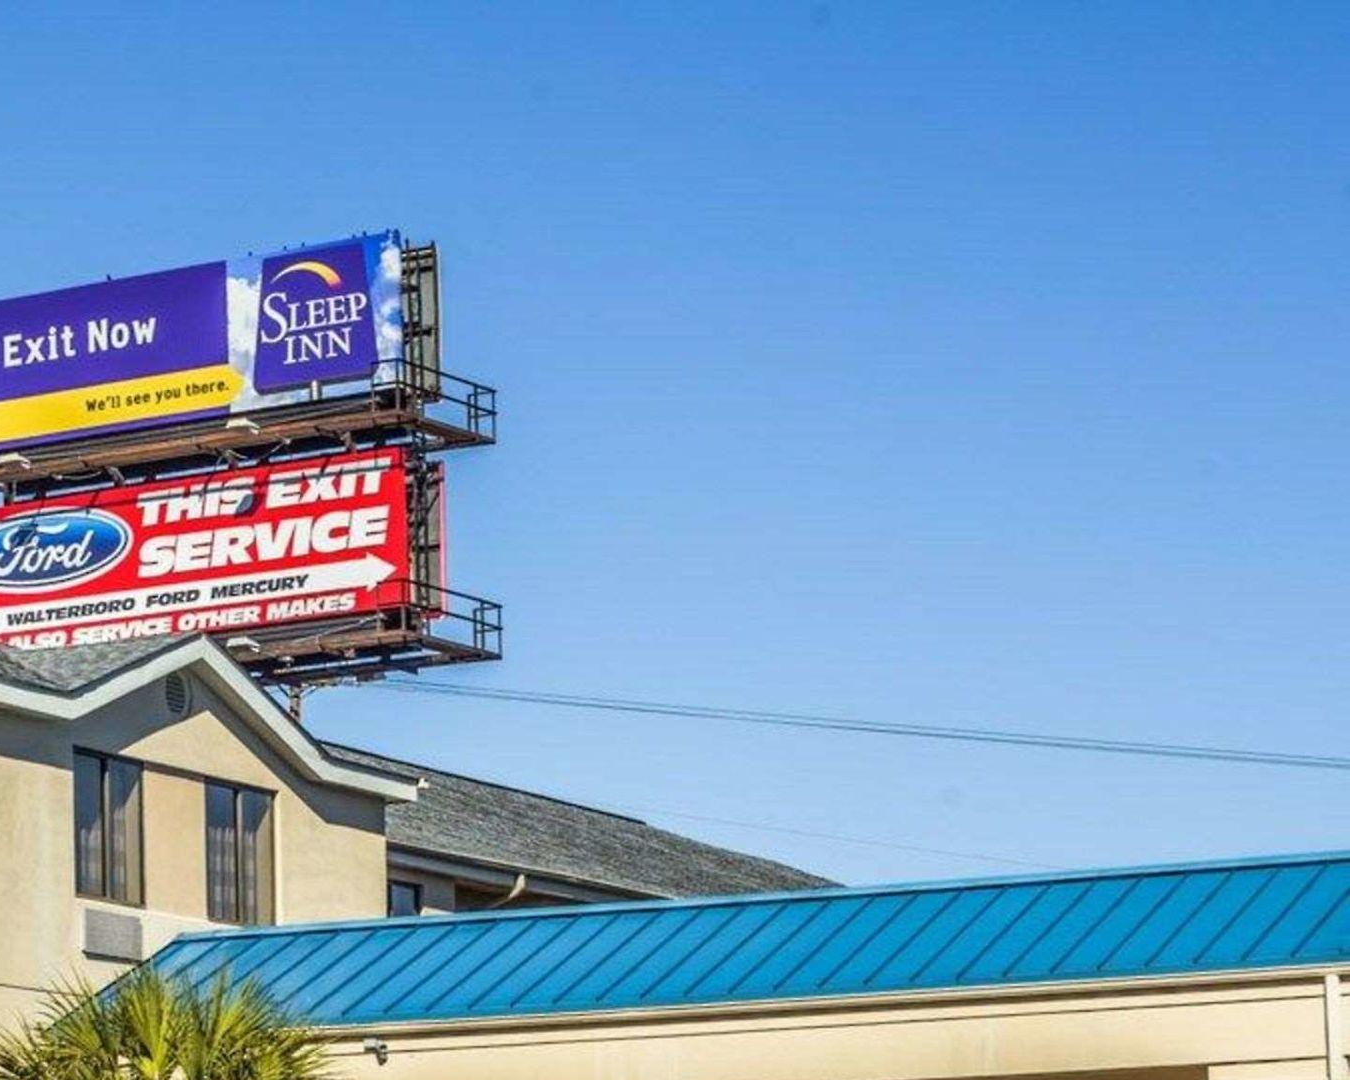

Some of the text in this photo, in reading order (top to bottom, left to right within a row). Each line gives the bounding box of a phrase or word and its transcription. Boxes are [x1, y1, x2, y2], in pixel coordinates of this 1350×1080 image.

[3, 317, 157, 368] Exit Now
[260, 291, 368, 344] SLEEP
[283, 327, 353, 365] INN
[85, 379, 230, 412] We'll see you there.
[136, 456, 392, 527] THIS EXIT
[137, 504, 391, 579] SERVICE
[7, 574, 310, 627] WALTERBORO FORD MERCURY
[7, 593, 356, 651] ALSO SERVICE OTHER MAKES
